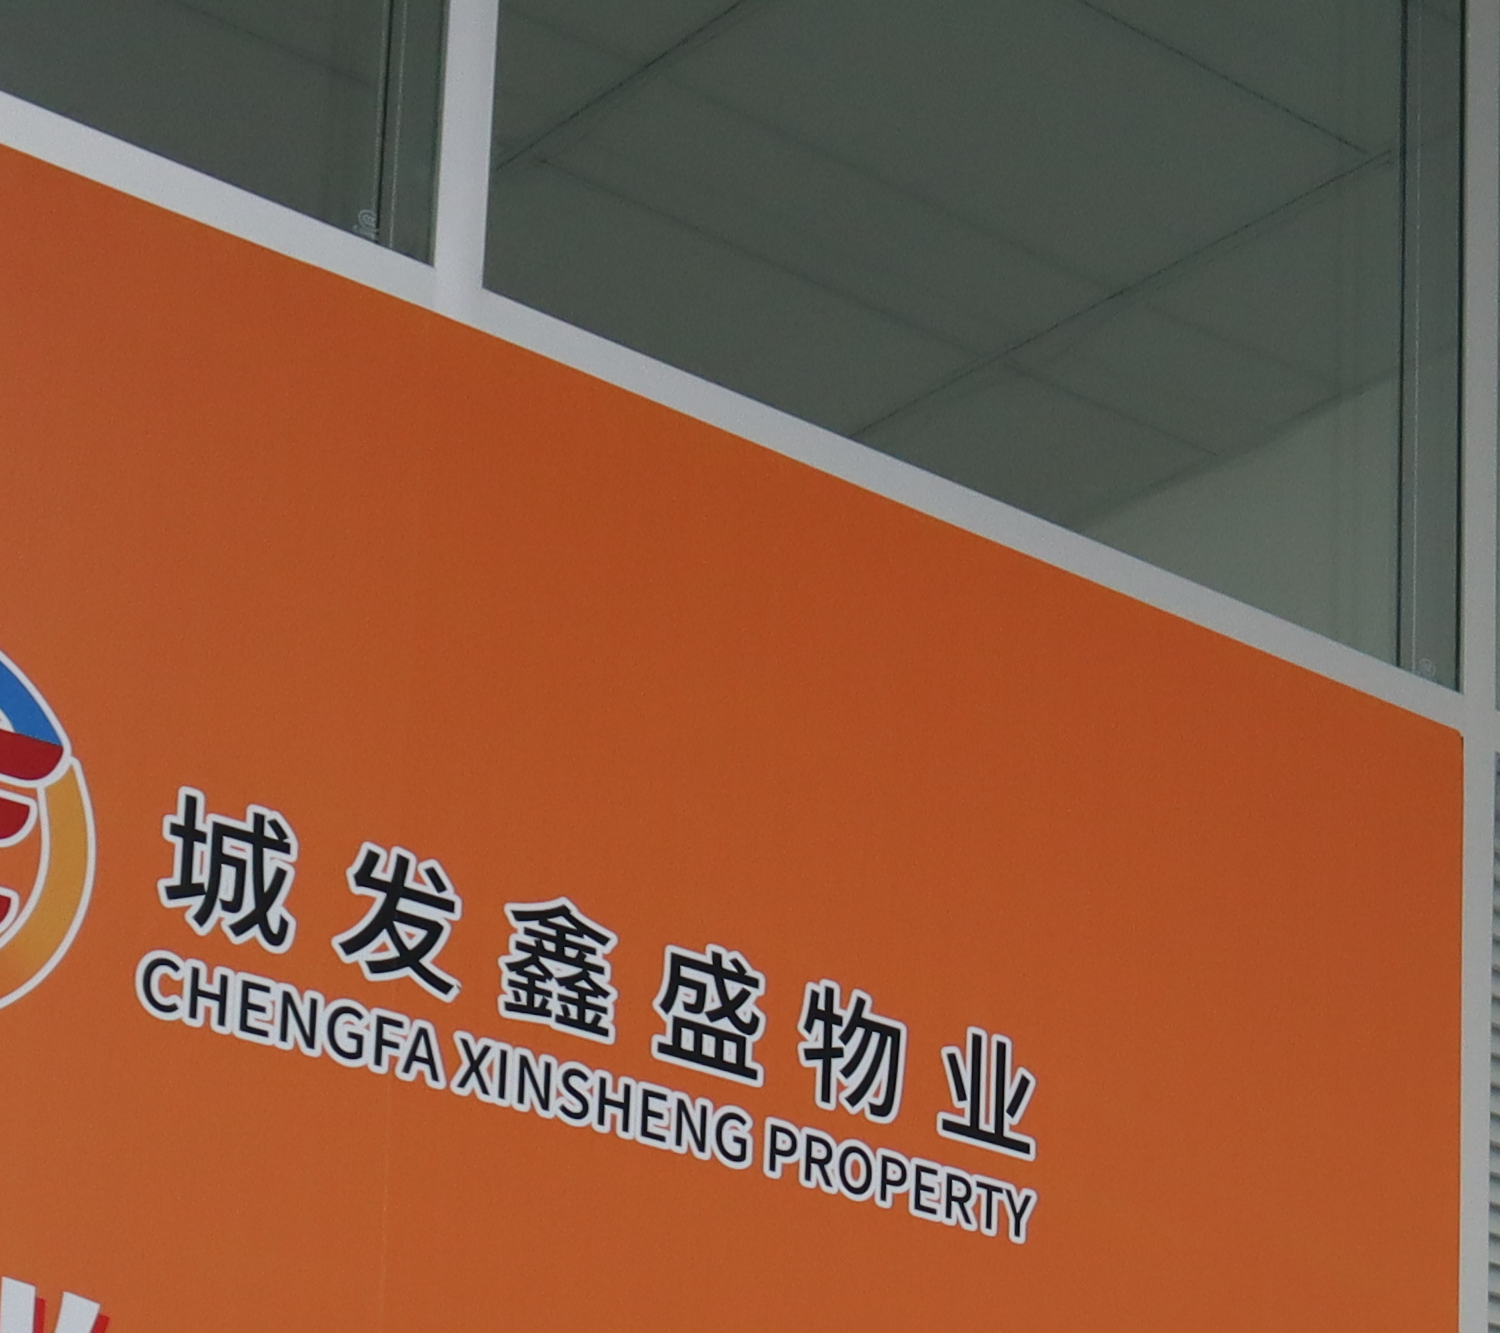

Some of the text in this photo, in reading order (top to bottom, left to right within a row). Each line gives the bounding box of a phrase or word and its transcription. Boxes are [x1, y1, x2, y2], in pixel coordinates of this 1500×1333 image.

[140, 955, 1034, 1240] CHENGFA XINSHENG PROPERTY
[160, 792, 1033, 1157] 城发鑫盛物业
